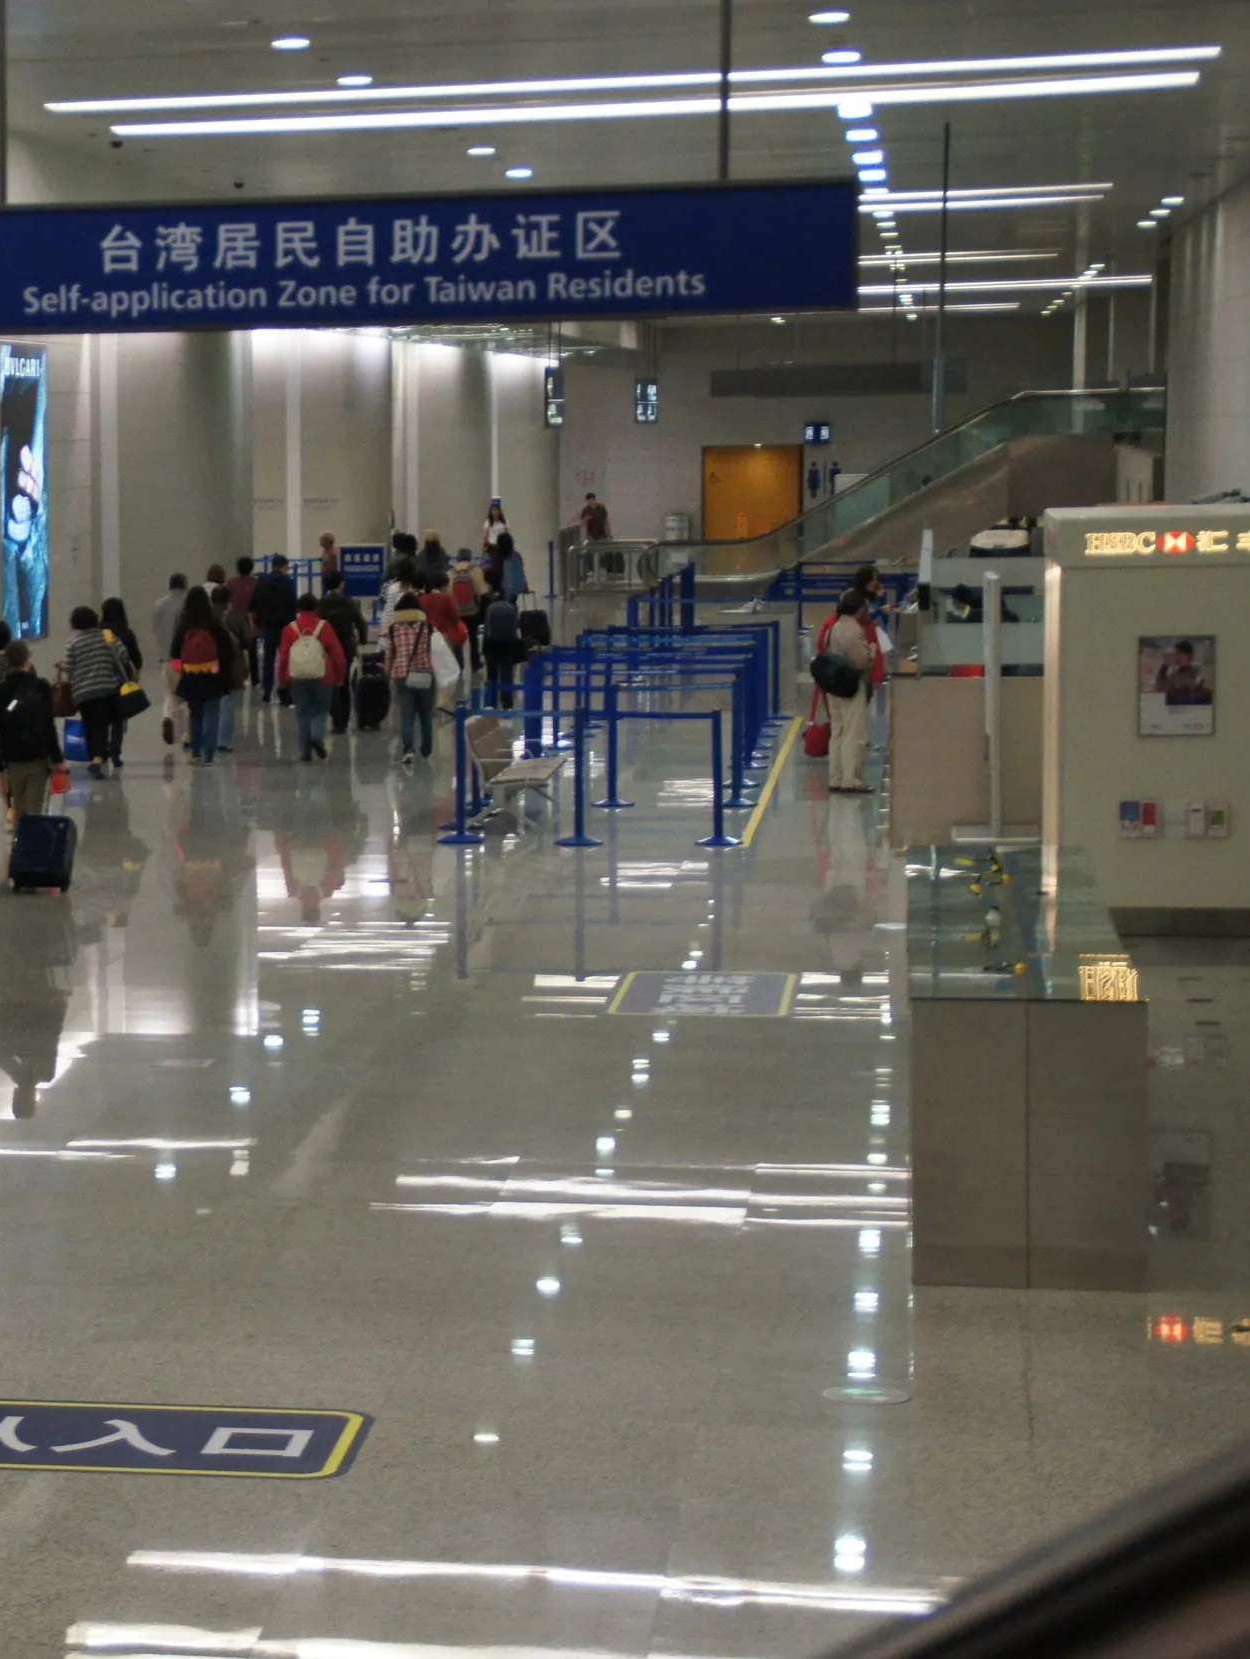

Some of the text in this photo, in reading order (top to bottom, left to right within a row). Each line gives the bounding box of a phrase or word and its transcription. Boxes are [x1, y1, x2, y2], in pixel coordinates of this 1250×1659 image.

[99, 210, 622, 273] 台湾居民自助办证区
[23, 269, 706, 318] Self-application Zone for Taiwan Residents
[1085, 531, 1156, 555] HSBC
